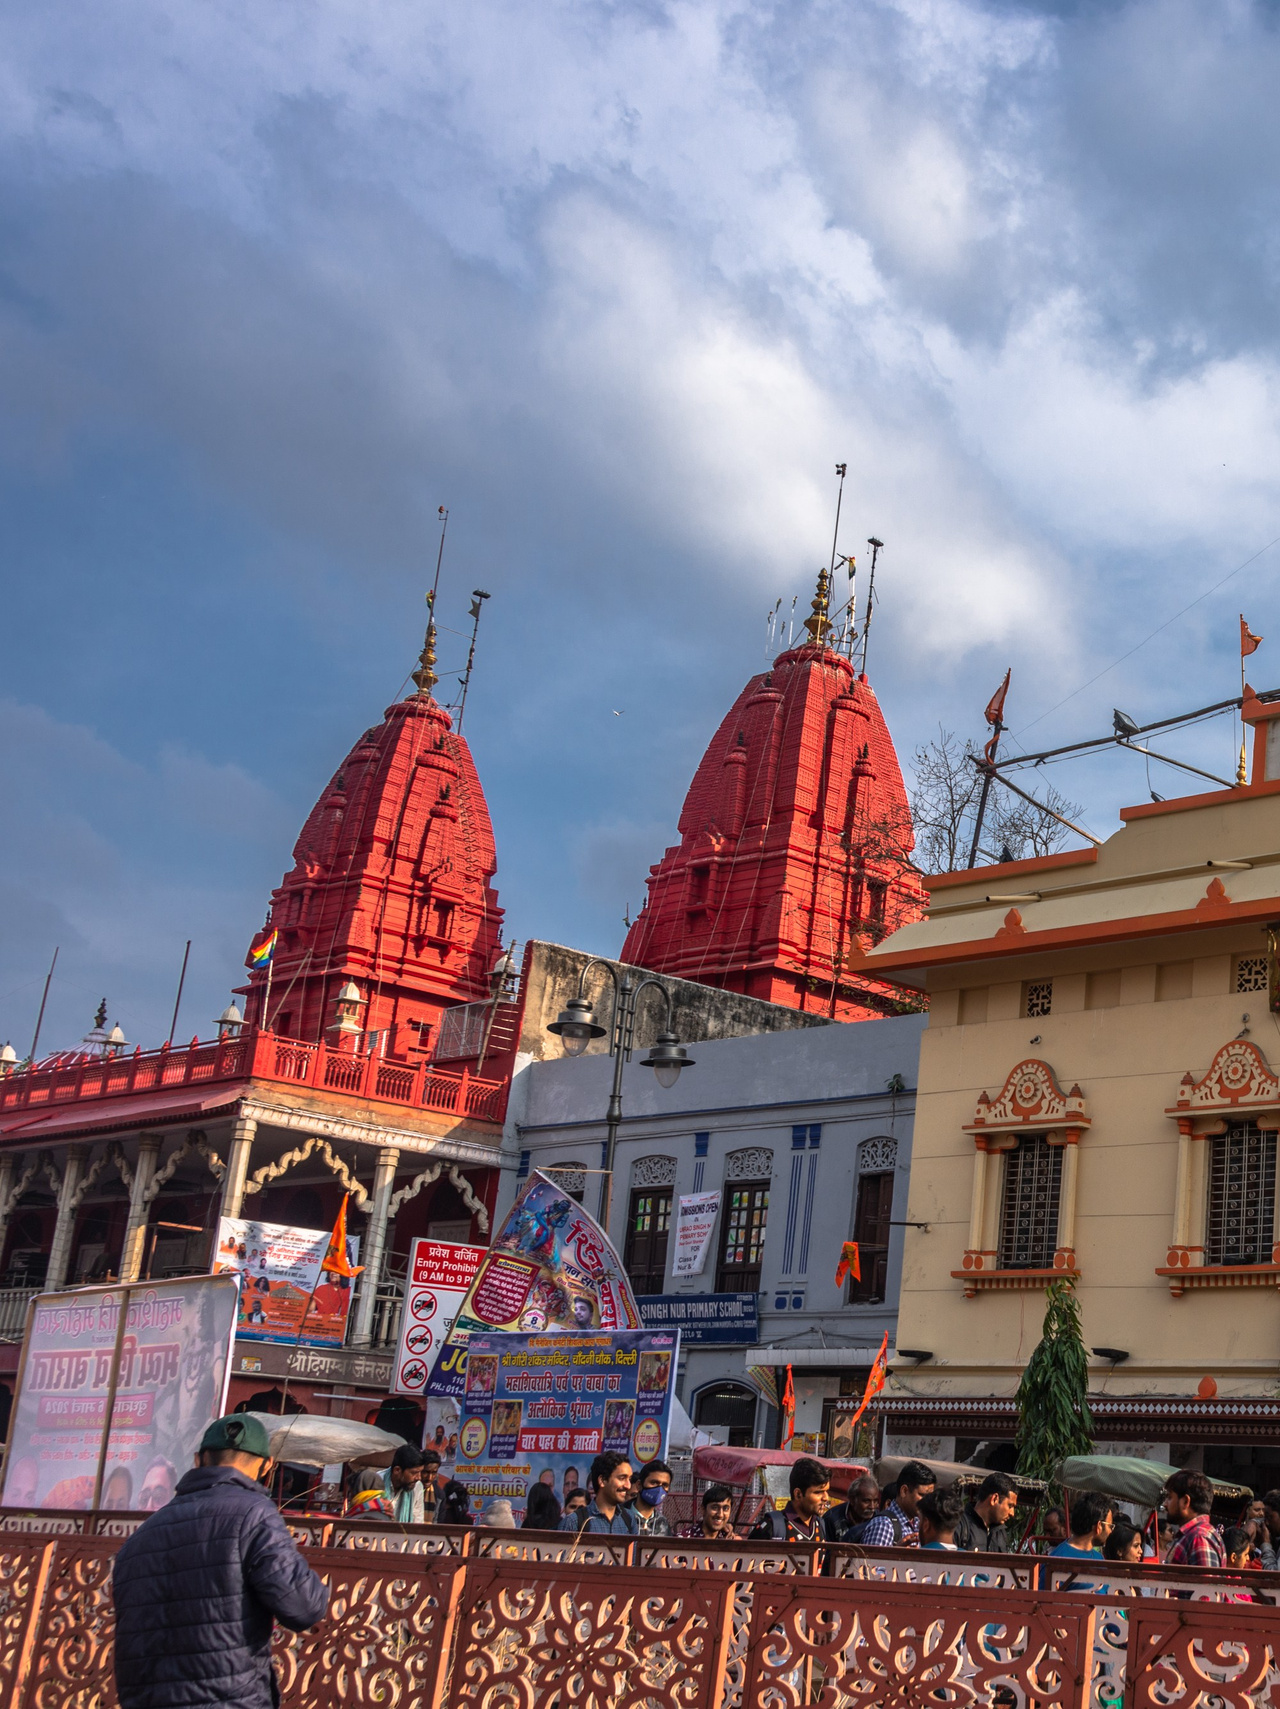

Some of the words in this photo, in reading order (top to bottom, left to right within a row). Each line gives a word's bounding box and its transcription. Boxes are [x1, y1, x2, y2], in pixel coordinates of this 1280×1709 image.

[428, 1245, 450, 1259] प्रवेश
[454, 1248, 479, 1262] वर्जित
[417, 1258, 440, 1270] Entry
[419, 1270, 428, 1281] (9
[429, 1272, 444, 1282] AM
[446, 1274, 455, 1283] to
[456, 1275, 463, 1284] 9
[641, 1303, 668, 1319] SINGH
[670, 1303, 686, 1319] NUR
[687, 1301, 719, 1318] PRIMARY
[719, 1301, 744, 1317] SCHOOL
[530, 1316, 538, 1325] 8
[501, 1352, 511, 1367] श्री
[511, 1351, 527, 1366] गौरी
[528, 1351, 546, 1366] शंकर
[615, 1349, 638, 1366] दिल्ली
[306, 1351, 351, 1376] दिगम्ब
[353, 1355, 376, 1379] जैन
[376, 1362, 393, 1381] ला
[452, 1376, 465, 1385] 116
[505, 1372, 554, 1393] महाशिवरात्रि
[555, 1371, 570, 1392] पर्व
[571, 1375, 583, 1392] पर
[585, 1374, 606, 1392] बाबा
[607, 1374, 622, 1392] का
[445, 1384, 465, 1396] 011-
[527, 1398, 567, 1419] अलौकिक
[466, 1440, 472, 1451] 8
[521, 1434, 535, 1450] चार
[539, 1434, 554, 1450] पहर
[557, 1432, 570, 1450] की
[572, 1432, 600, 1451] आरती
[455, 1462, 476, 1474] आपको
[501, 1463, 521, 1475] परिवार
